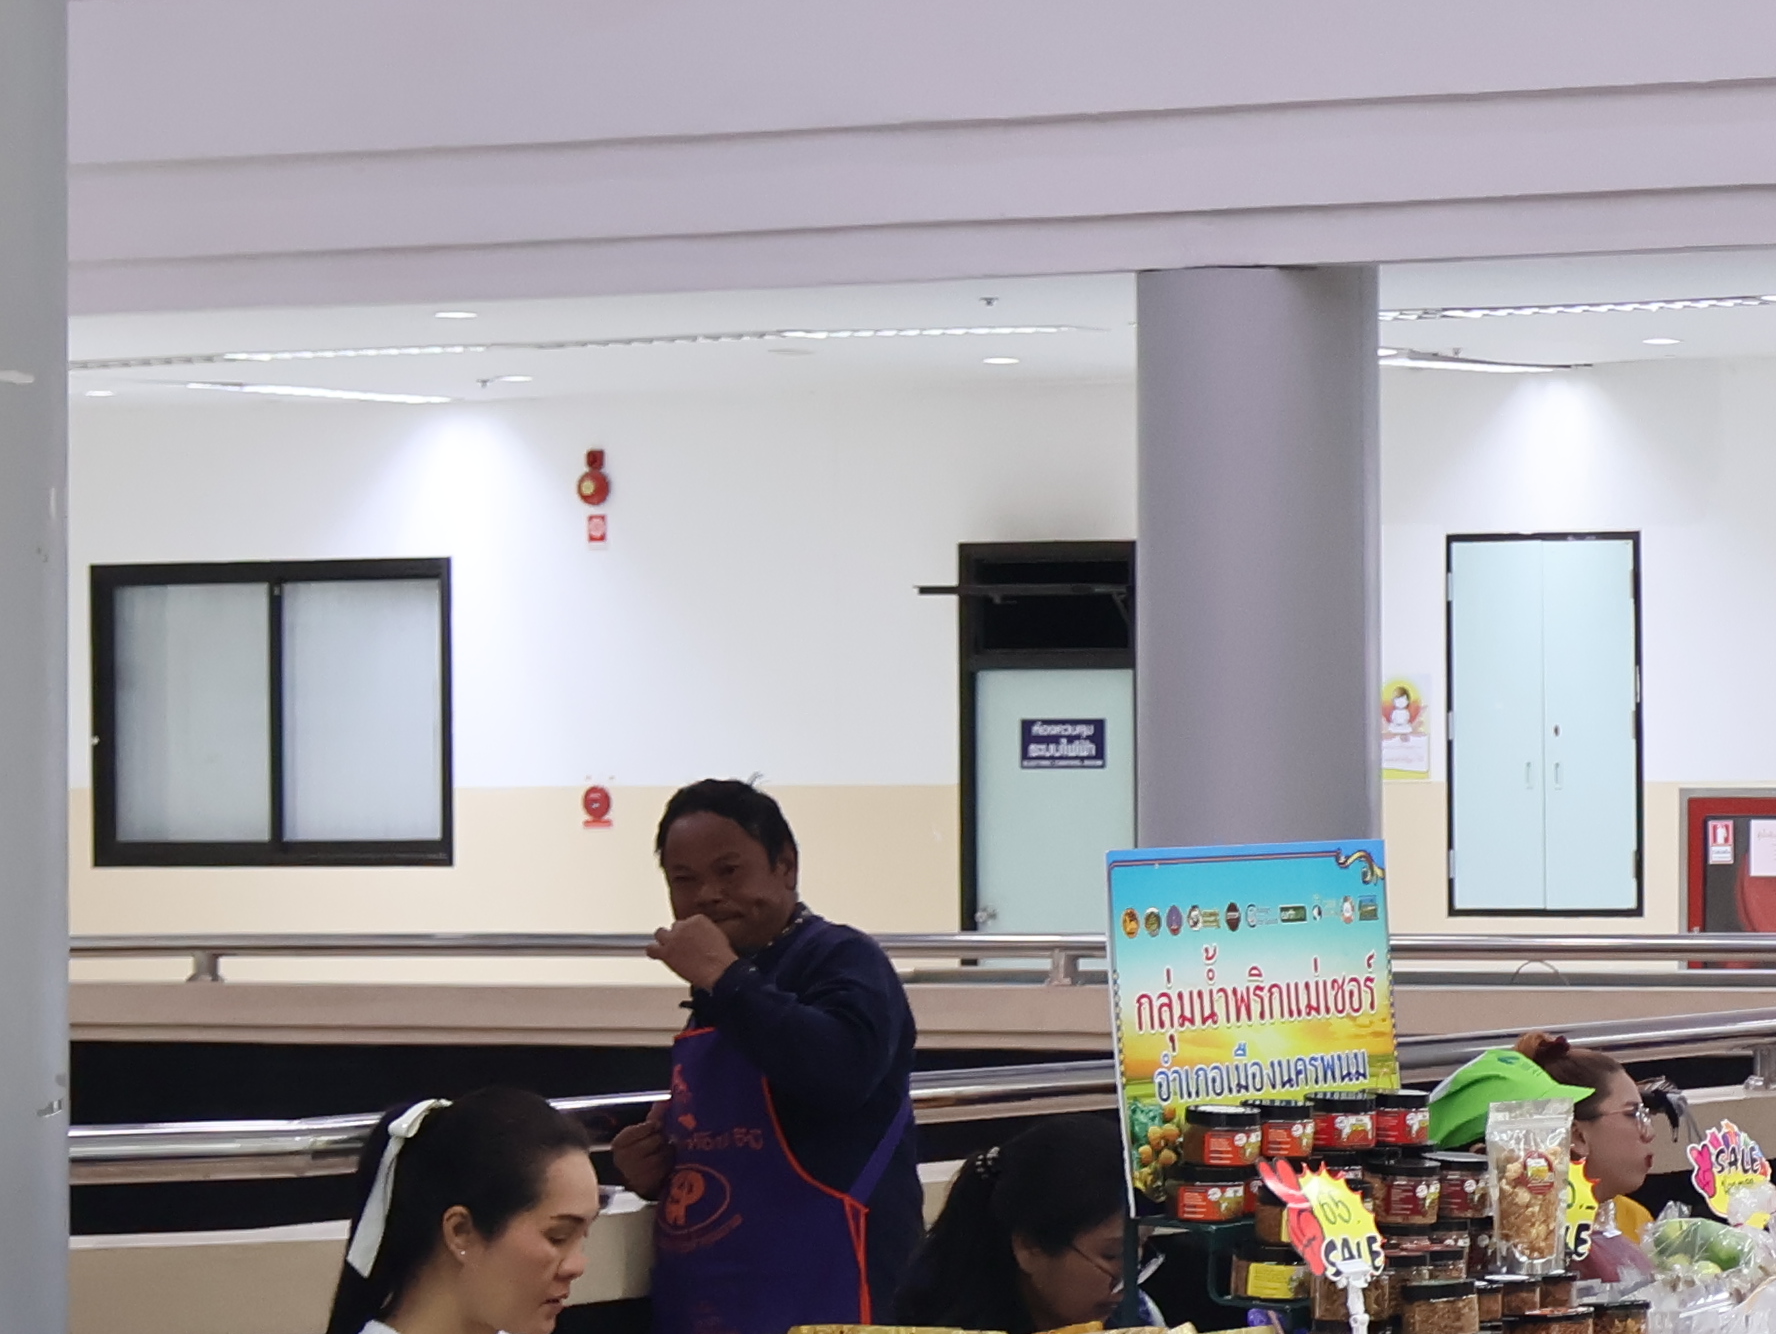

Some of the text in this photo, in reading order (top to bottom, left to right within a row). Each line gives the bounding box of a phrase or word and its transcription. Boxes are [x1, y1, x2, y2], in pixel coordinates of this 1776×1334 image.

[1135, 943, 1378, 1055] กลุ่มน้ำพริกแม่เชอร์
[1154, 1040, 1371, 1104] อำเภอเมืองนครพนม
[1715, 1145, 1760, 1175] SALE
